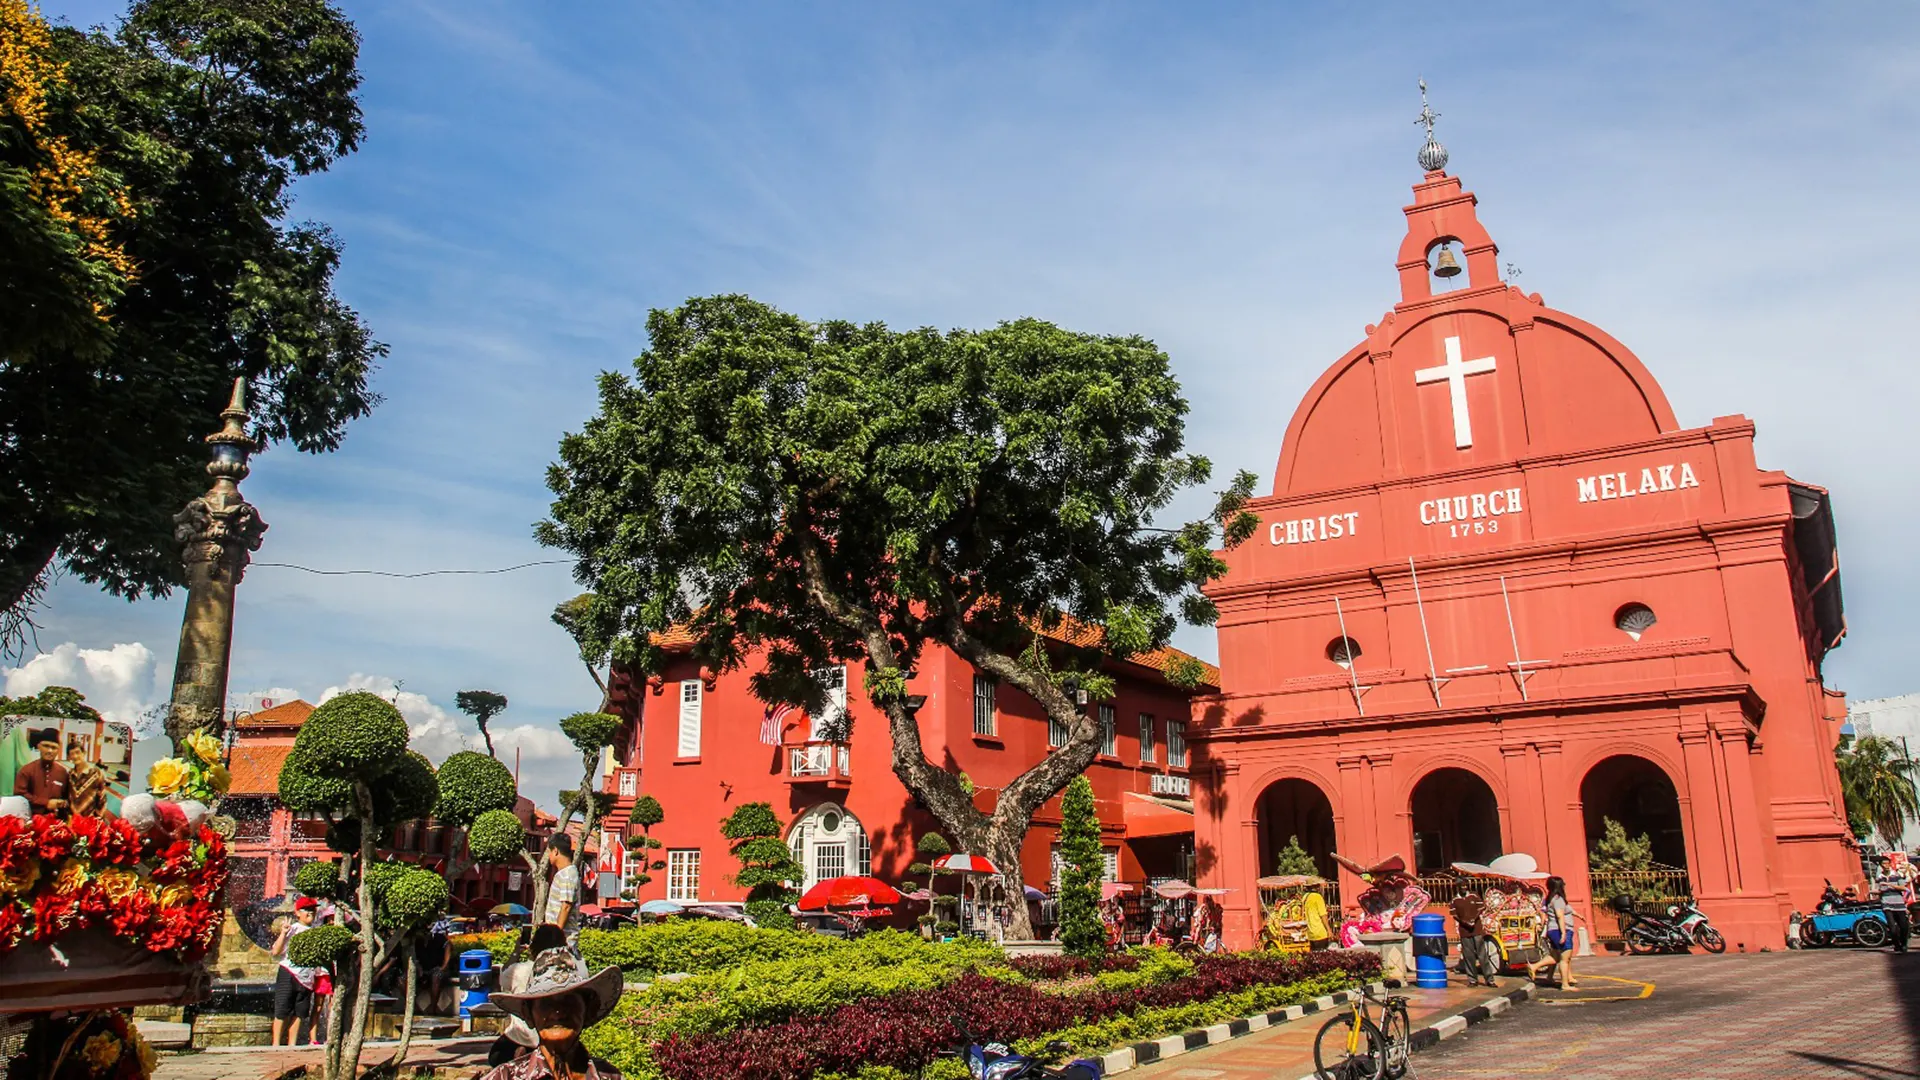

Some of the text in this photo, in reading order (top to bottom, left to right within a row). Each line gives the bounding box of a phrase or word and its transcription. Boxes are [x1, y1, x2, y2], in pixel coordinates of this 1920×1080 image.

[1269, 461, 1699, 545] CHRIST CHURCH MELAKA
[1449, 519, 1499, 538] 1753
